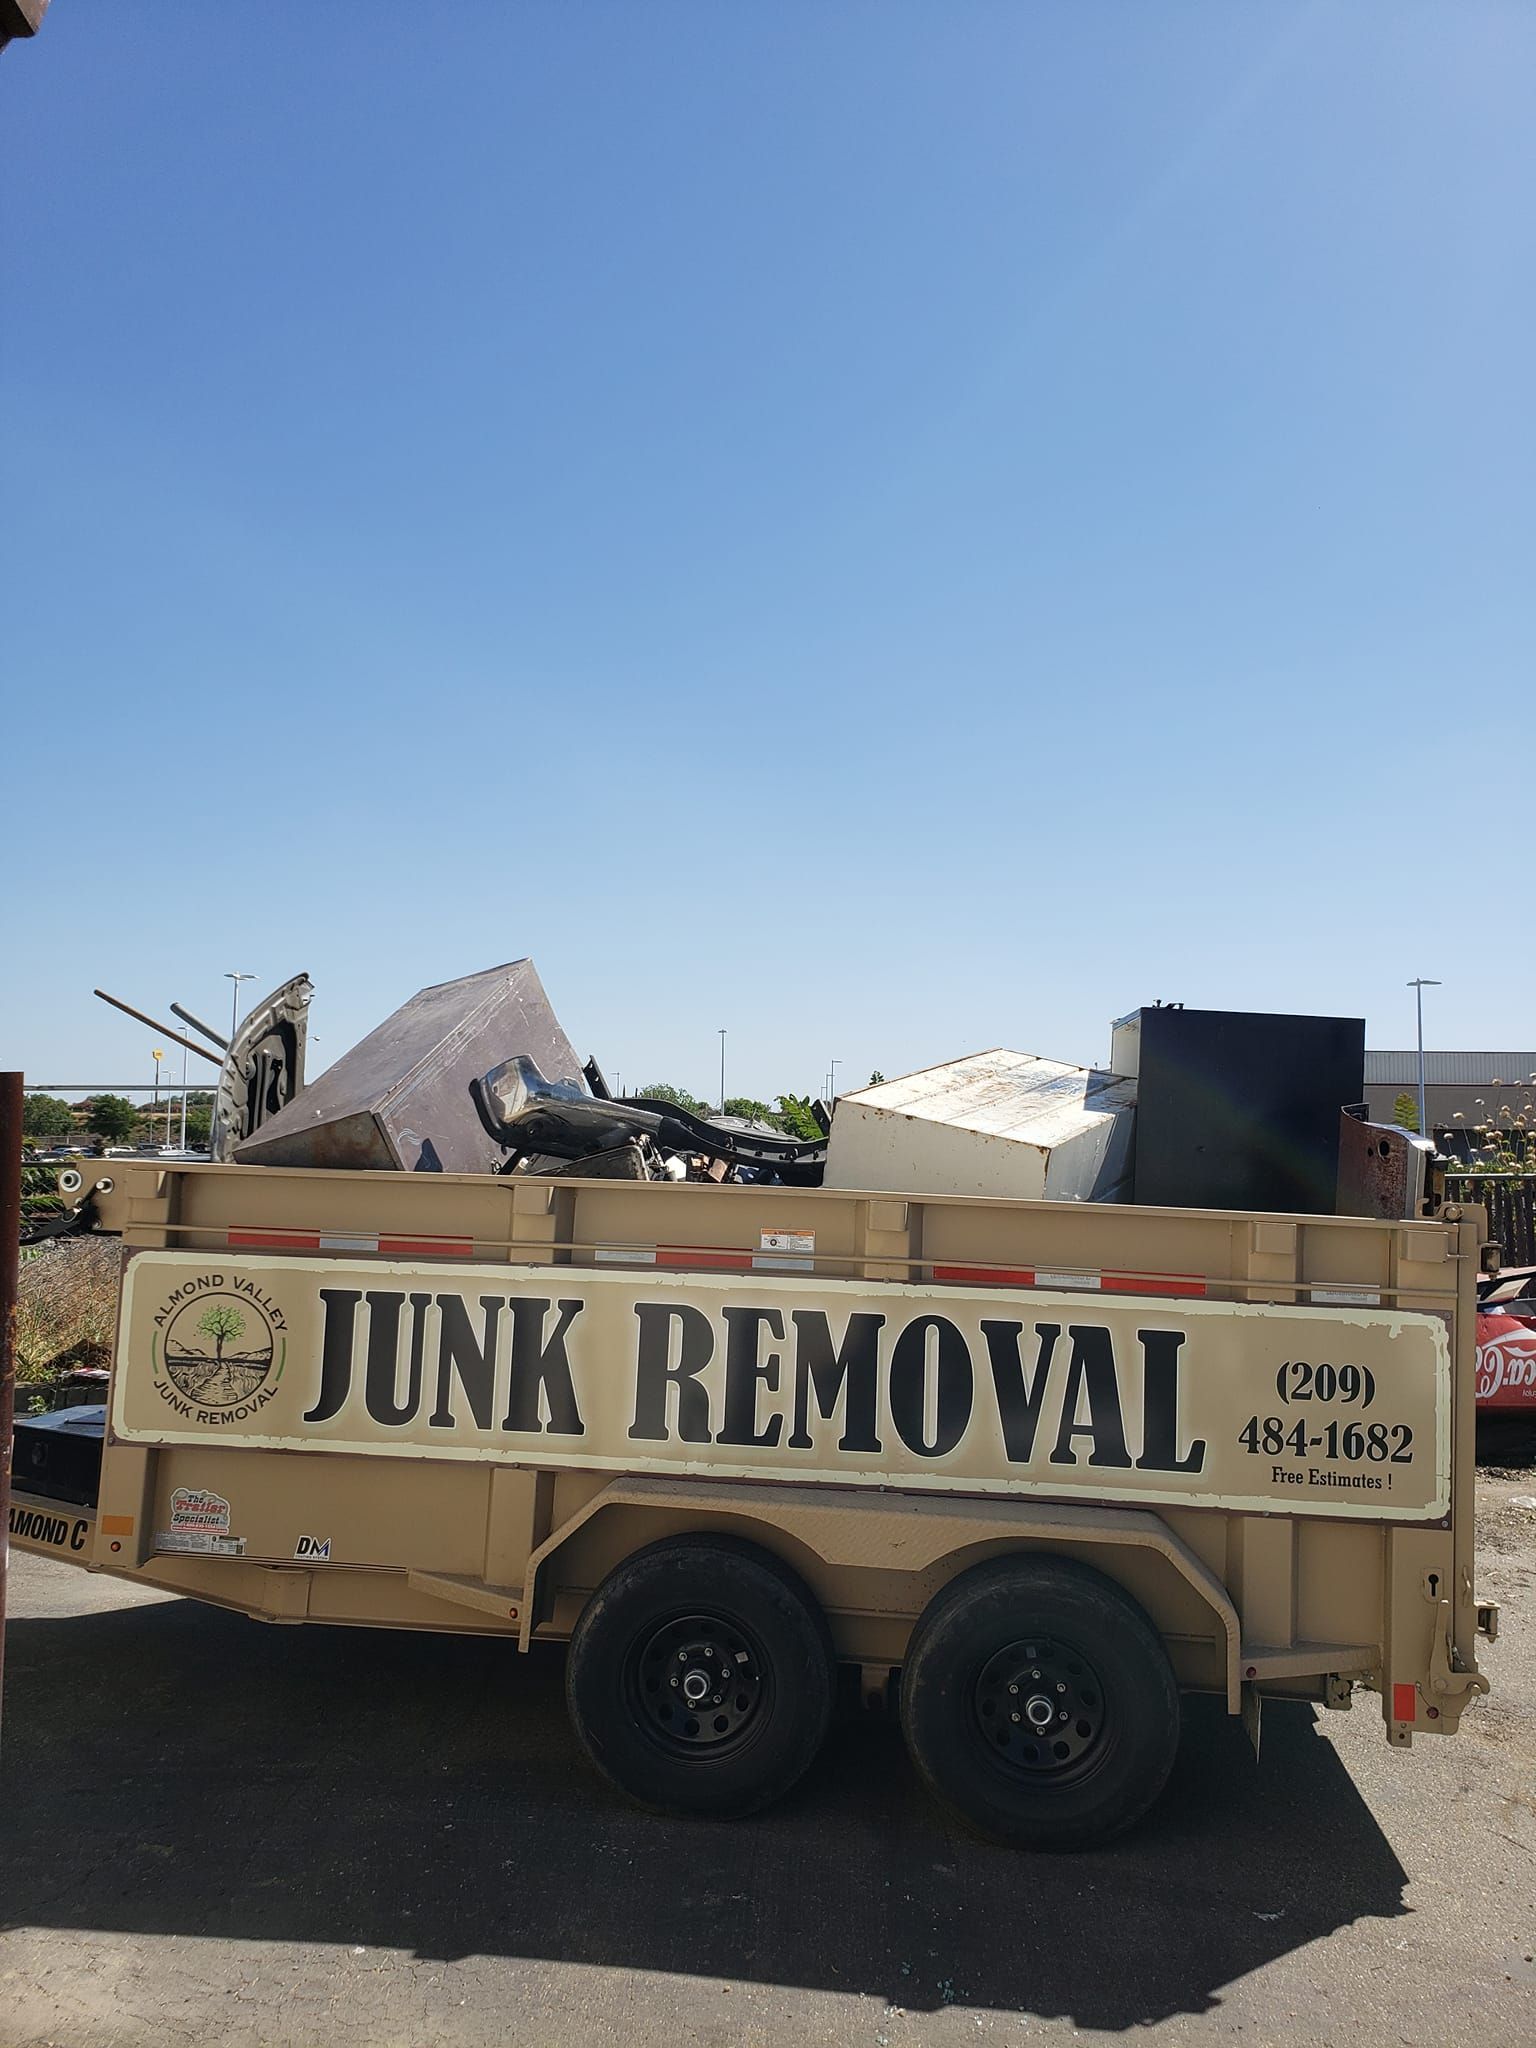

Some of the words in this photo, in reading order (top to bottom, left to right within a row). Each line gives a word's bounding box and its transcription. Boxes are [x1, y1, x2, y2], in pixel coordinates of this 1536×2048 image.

[154, 1275, 224, 1328] ALMOND
[233, 1276, 288, 1332] VALLEY
[303, 1288, 585, 1436] JUNK
[627, 1302, 1207, 1474] REMOVAL
[1276, 1361, 1376, 1410] (209)
[154, 1380, 194, 1418] JUNK
[196, 1387, 279, 1425] REMOVAL
[1238, 1415, 1413, 1464] 484-1682
[1271, 1466, 1304, 1484] Free
[175, 1500, 226, 1513] Trailer
[187, 1494, 204, 1504] The
[70, 1519, 88, 1551] C
[173, 1513, 220, 1525] Specialist
[296, 1536, 330, 1556] DM
